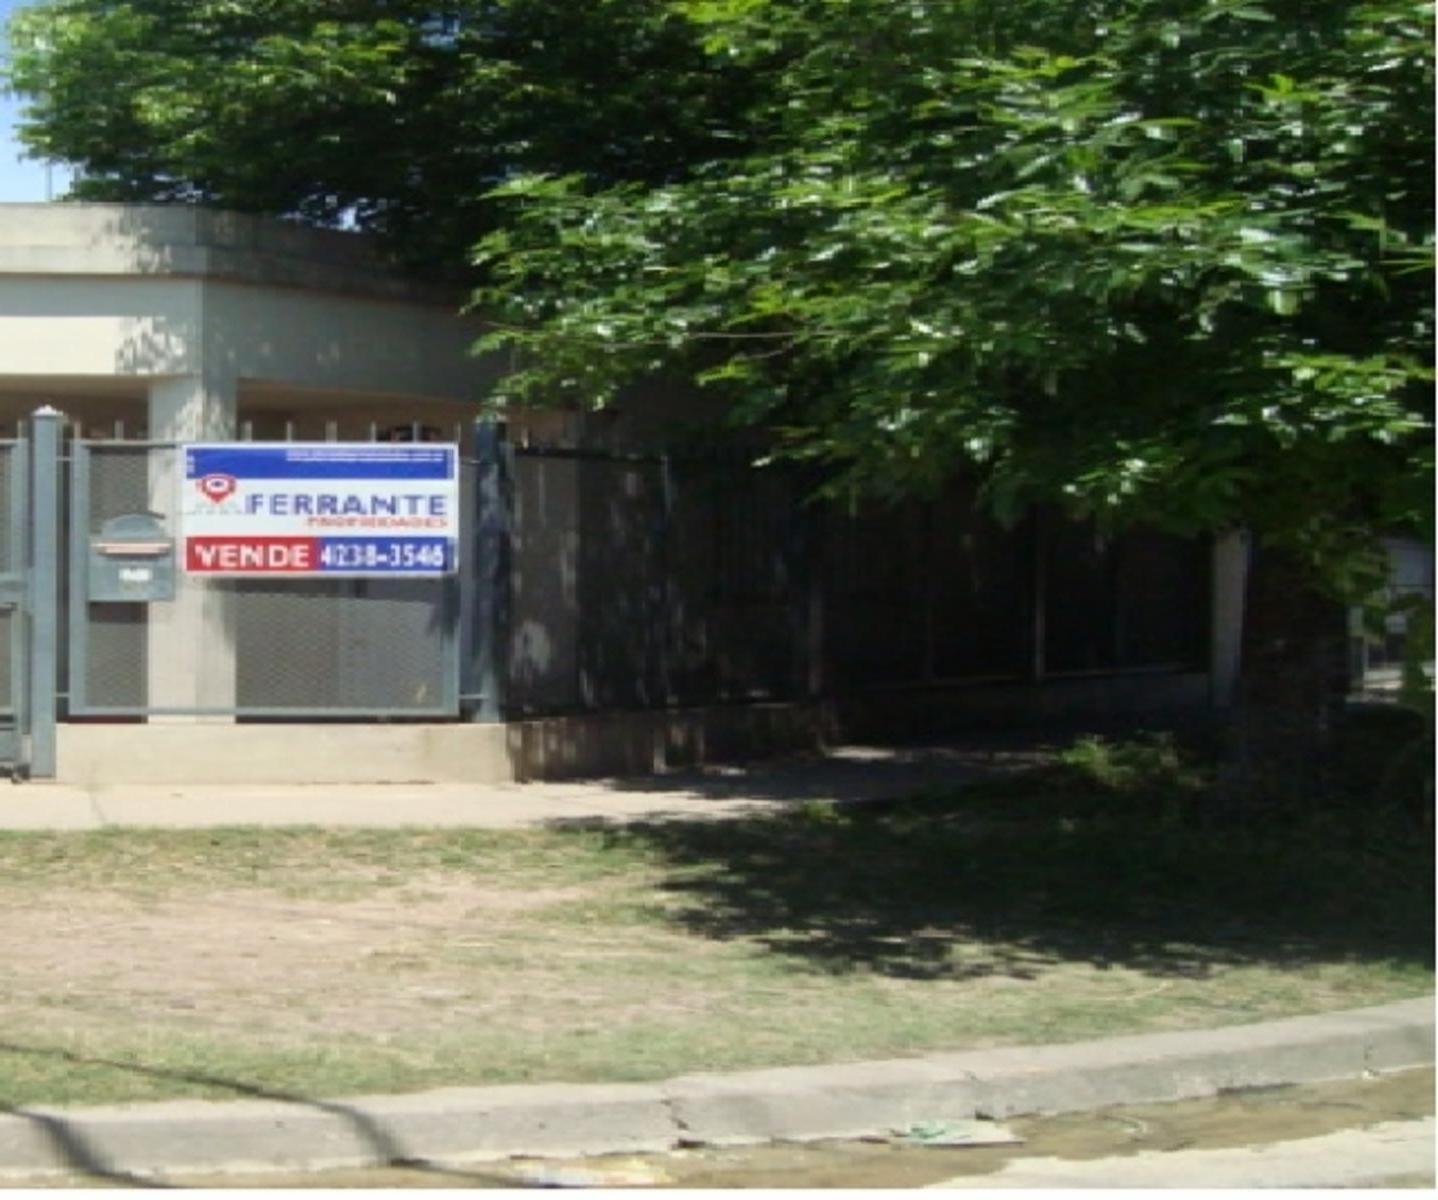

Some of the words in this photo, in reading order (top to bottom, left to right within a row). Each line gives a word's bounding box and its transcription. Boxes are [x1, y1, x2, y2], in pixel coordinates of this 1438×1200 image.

[245, 493, 448, 515] FERRANTE
[194, 544, 310, 568] VENDE
[320, 543, 444, 568] 4238-3546
